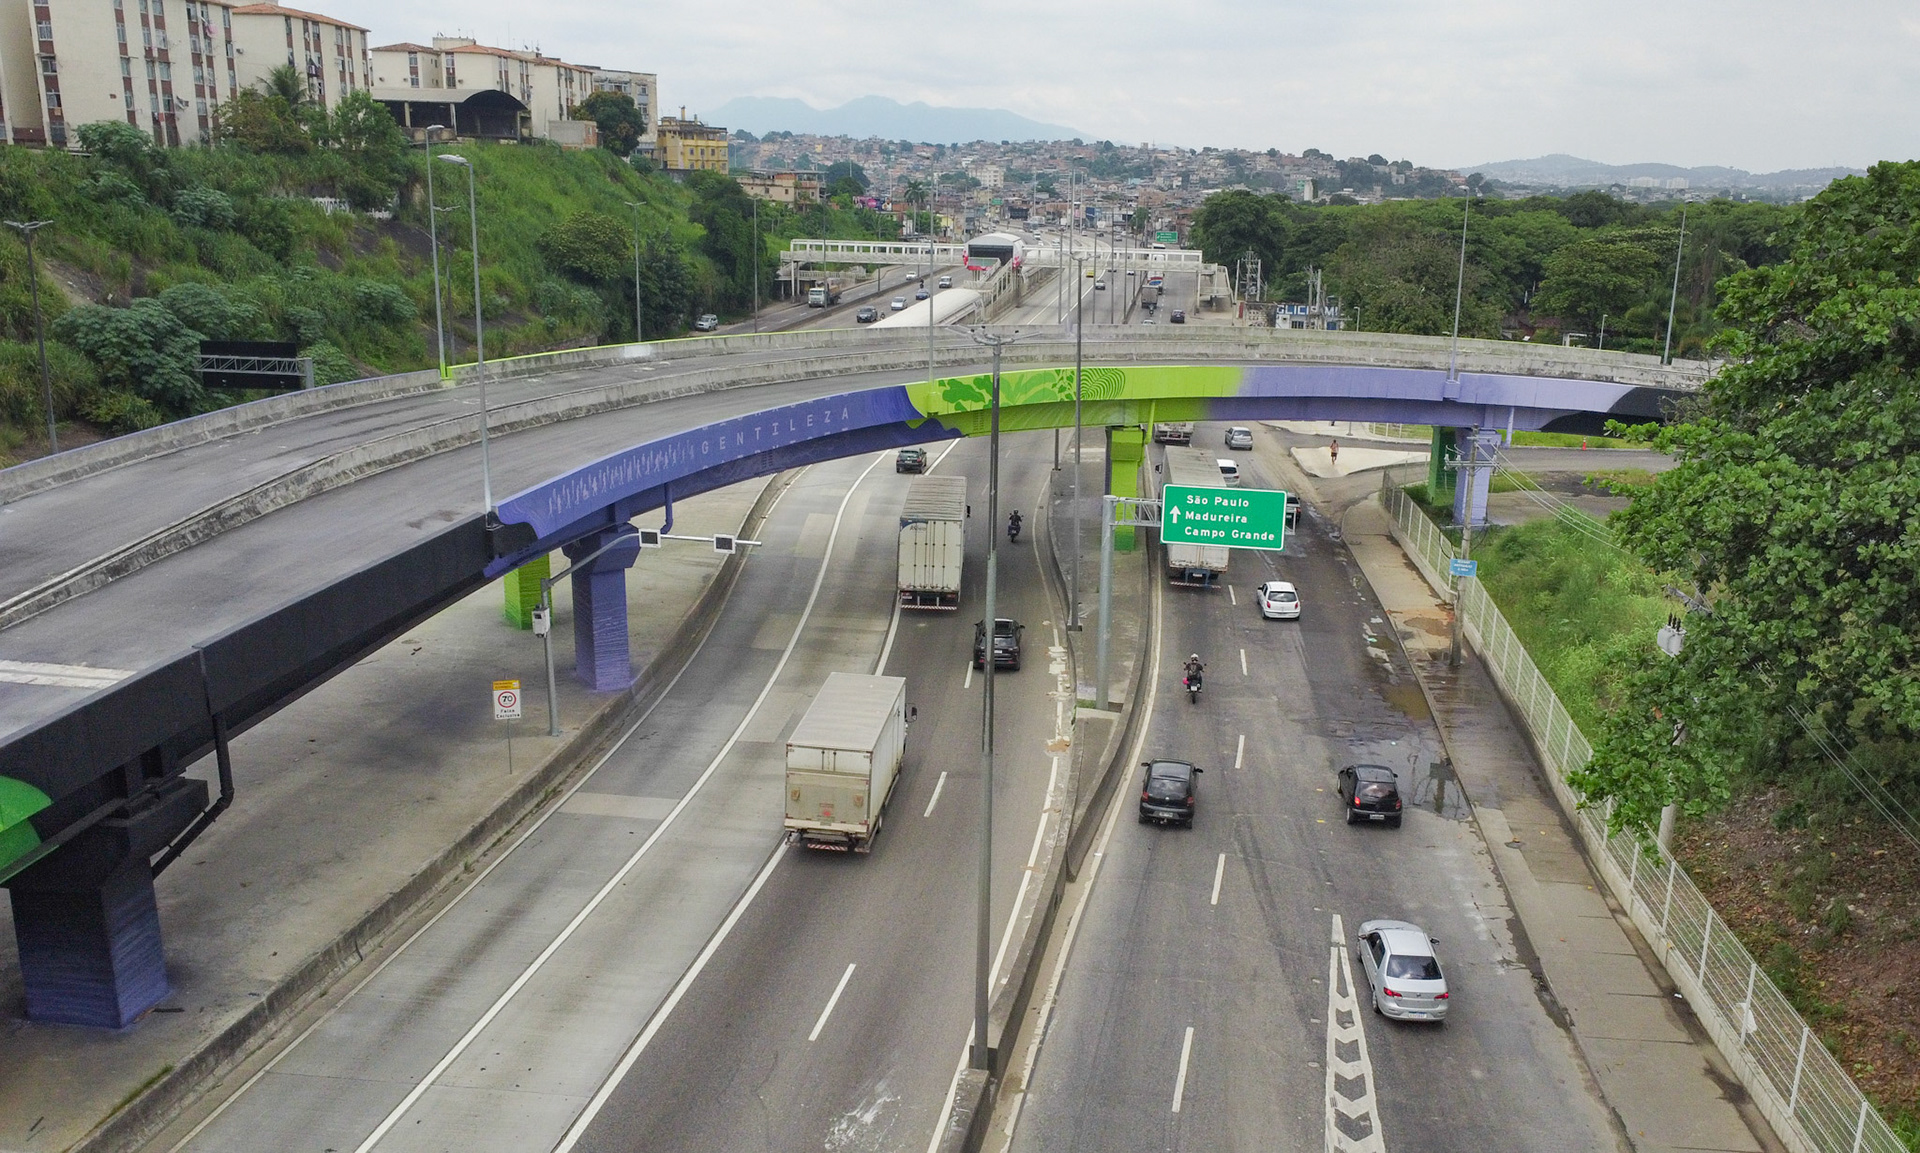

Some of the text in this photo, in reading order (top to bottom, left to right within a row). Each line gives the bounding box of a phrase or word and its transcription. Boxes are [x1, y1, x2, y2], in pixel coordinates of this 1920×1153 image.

[702, 407, 849, 455] GENTILEZA
[1186, 494, 1250, 508] São Paulo
[1185, 510, 1248, 524] Madureira
[1184, 526, 1275, 541] Campo Grande
